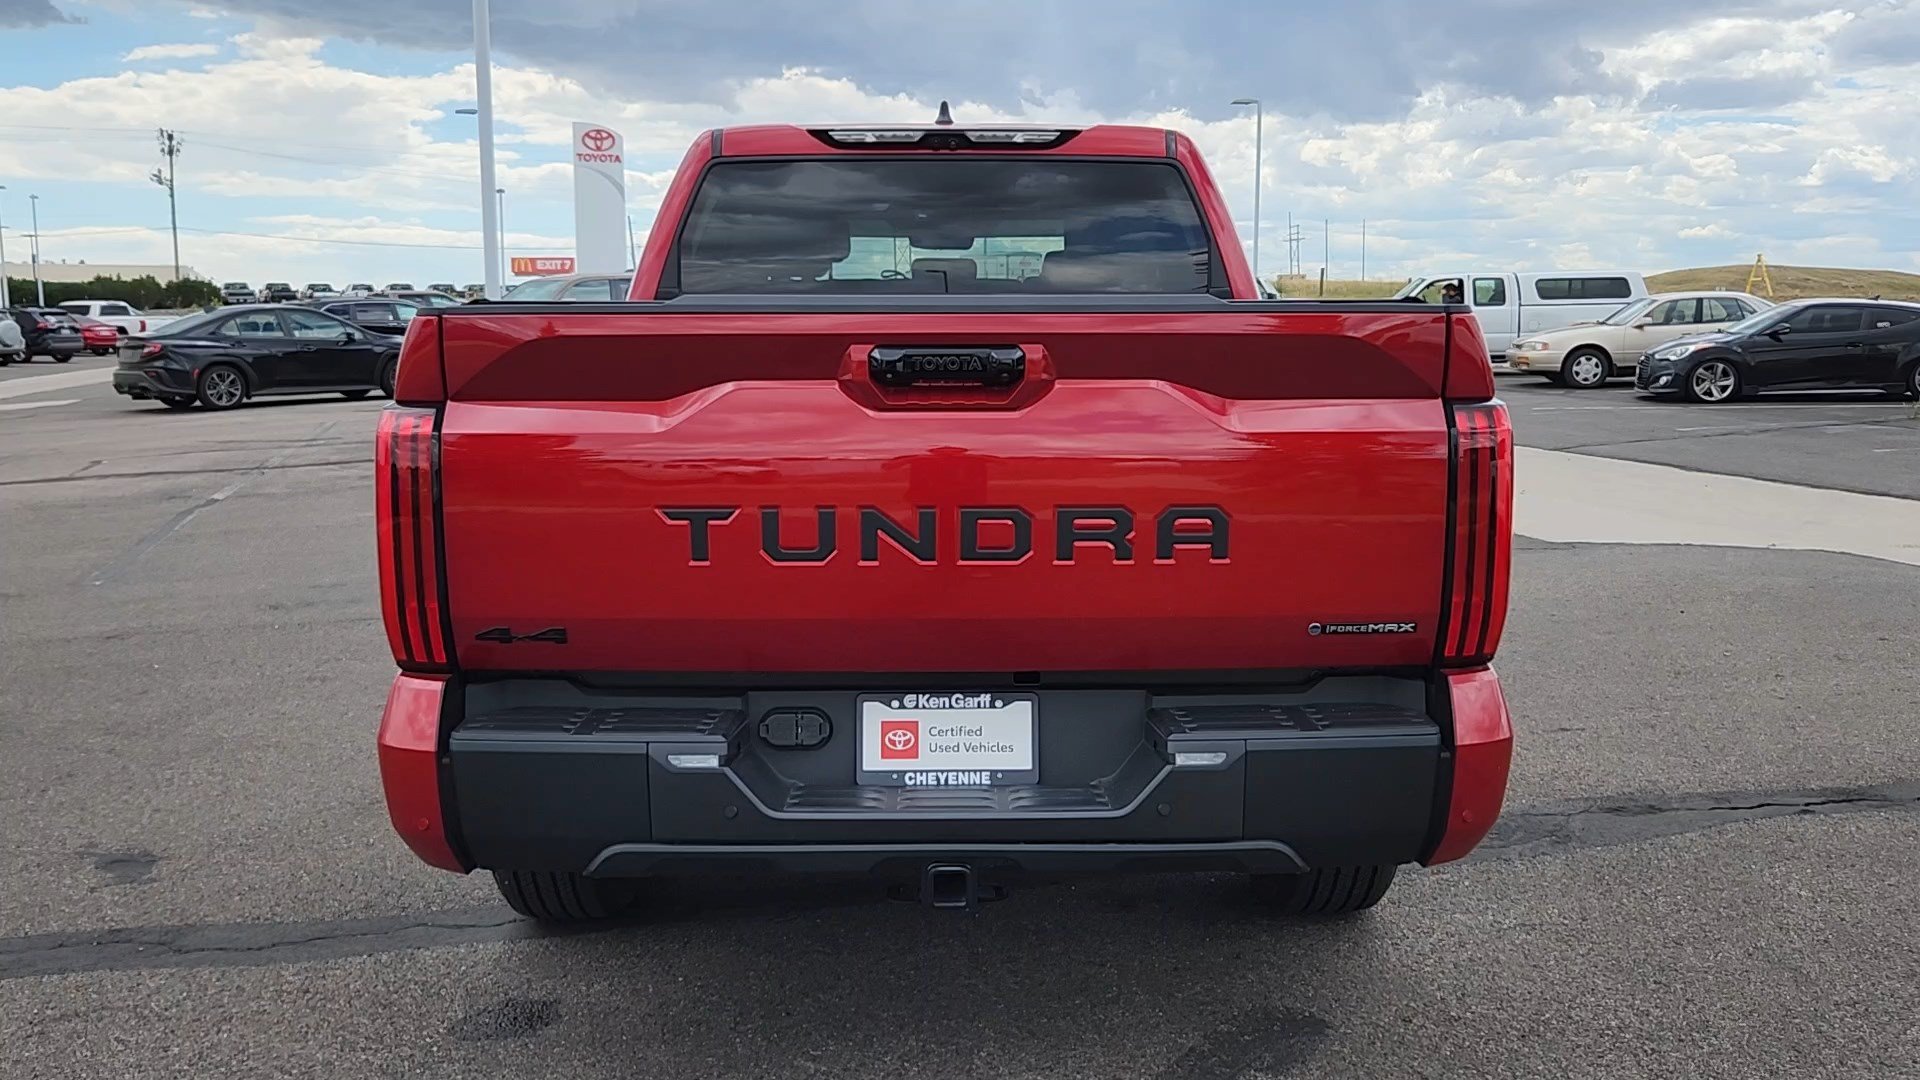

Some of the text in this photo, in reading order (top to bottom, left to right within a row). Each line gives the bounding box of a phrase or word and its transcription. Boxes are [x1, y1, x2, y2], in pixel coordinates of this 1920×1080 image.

[576, 153, 622, 163] TOYOTA
[536, 260, 561, 270] EXIT
[563, 260, 571, 270] 7
[912, 356, 982, 371] TOYOTA
[654, 505, 1233, 567] TUNDRA
[918, 694, 949, 708] Ken
[951, 694, 991, 708] Garff
[928, 726, 983, 737] Certified
[928, 742, 1014, 753] Used Vehicles
[904, 771, 991, 785] CHEYENNE
